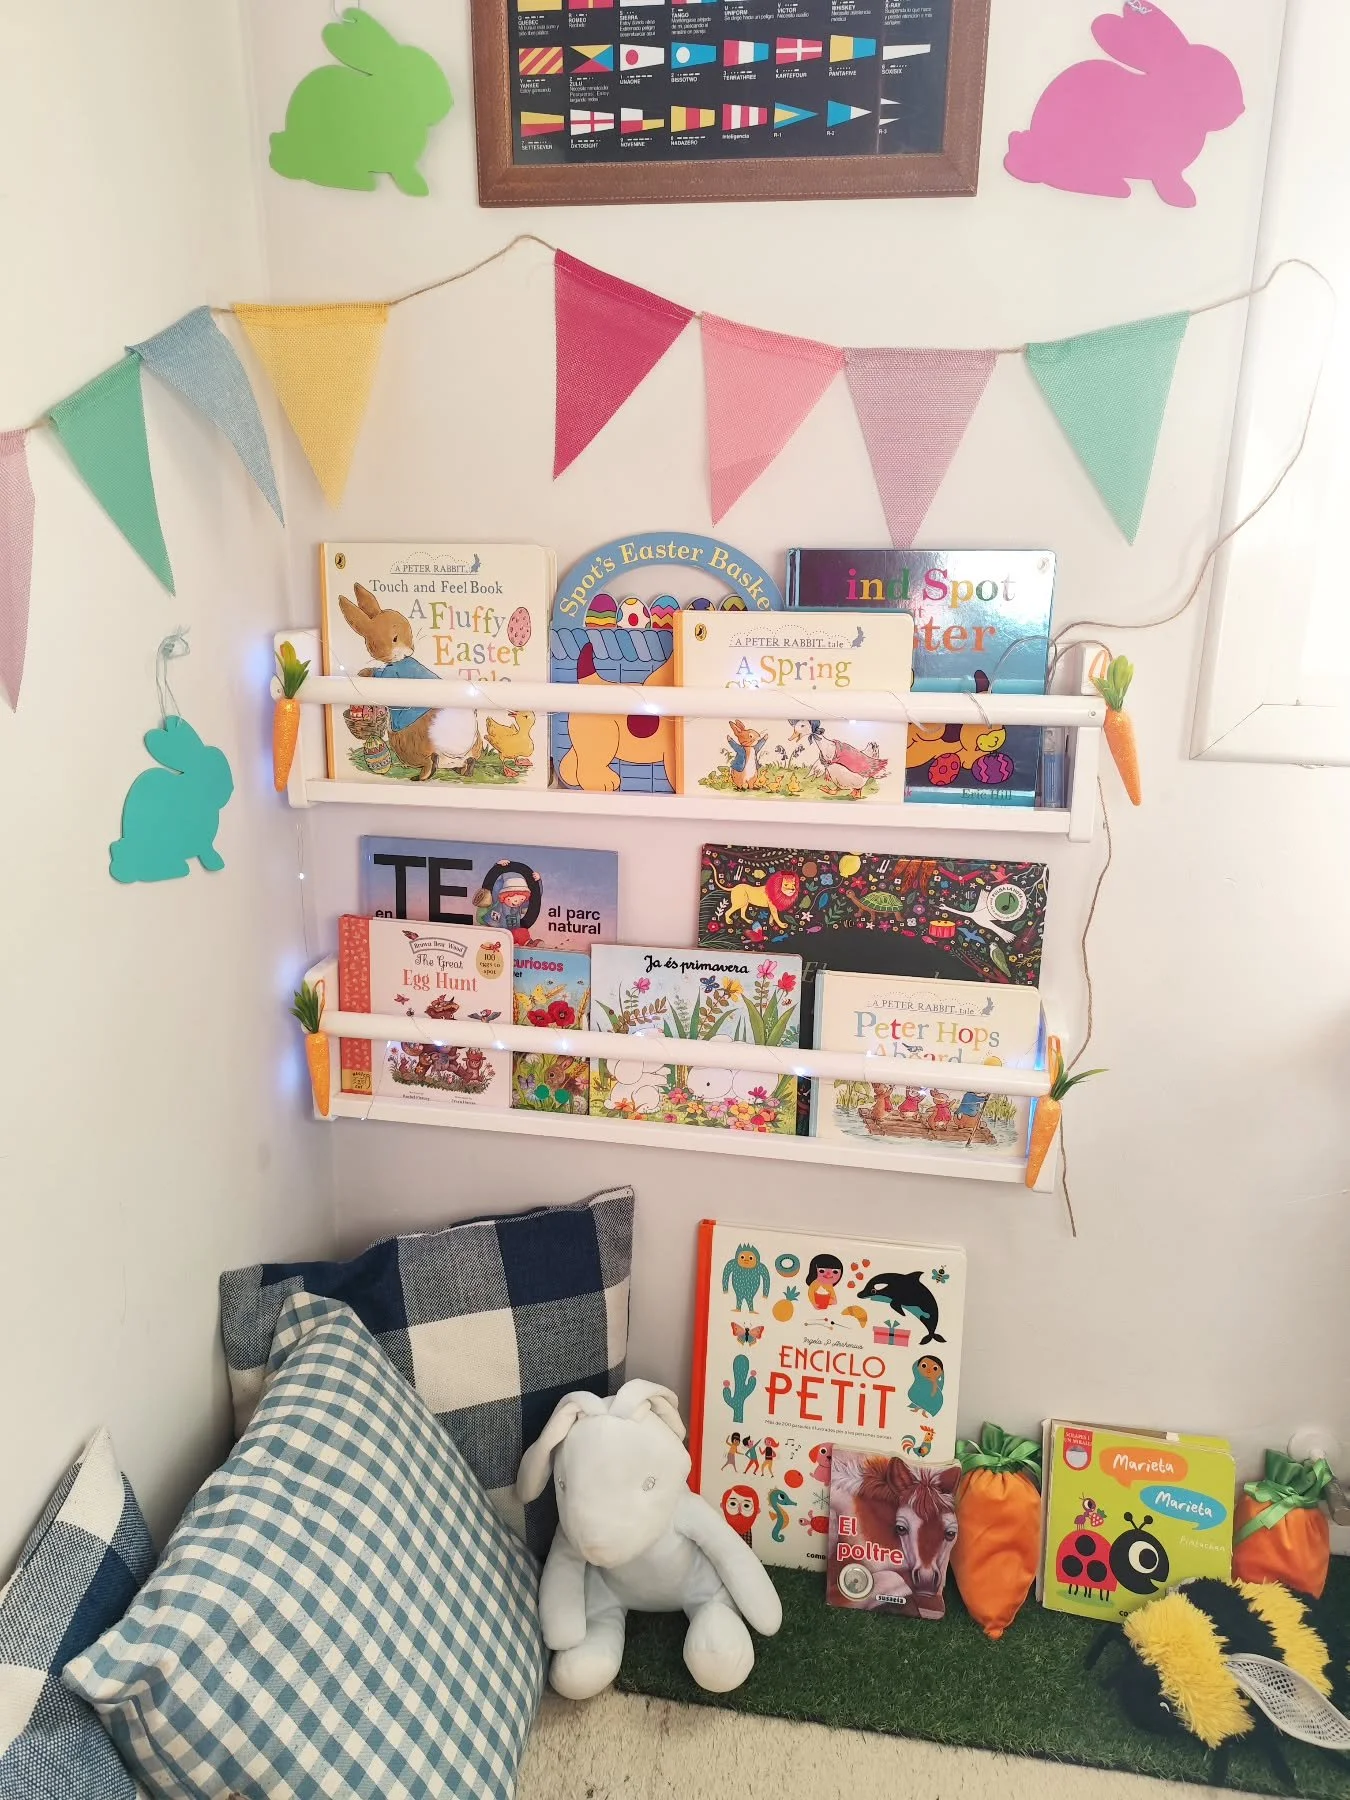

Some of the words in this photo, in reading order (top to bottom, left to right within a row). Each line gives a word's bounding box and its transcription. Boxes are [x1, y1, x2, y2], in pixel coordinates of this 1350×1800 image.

[402, 564, 430, 573] PETER
[433, 564, 466, 574] RABBIT
[619, 541, 704, 566] Easter
[708, 546, 776, 612] Baske
[369, 579, 408, 593] Touch
[413, 580, 436, 593] and
[440, 580, 467, 594] Feel
[470, 580, 504, 594] Book
[846, 567, 912, 602] ind
[922, 568, 1017, 609] Spot
[408, 598, 428, 620] A
[428, 602, 506, 638] Fluffy
[432, 634, 524, 666] Easter
[735, 638, 743, 647] A
[745, 637, 779, 648] PETER
[782, 638, 824, 648] RABBIT
[828, 640, 844, 649] tale
[736, 656, 754, 676] A
[760, 655, 852, 688] Spring
[961, 788, 987, 800] Eric
[990, 788, 1012, 800] Hill
[373, 853, 542, 928] TEO
[375, 909, 393, 920] en
[548, 906, 562, 918] al
[566, 908, 601, 924] parc
[548, 920, 602, 936] natural
[413, 941, 432, 950] Brown
[414, 953, 434, 967] The
[436, 954, 464, 972] Great
[484, 953, 496, 962] 100
[644, 954, 663, 973] Ja
[664, 956, 679, 970] és
[679, 959, 750, 974] primavera
[402, 968, 431, 992] Egg
[436, 971, 479, 993] Hunt
[873, 1000, 879, 1008] A
[882, 1000, 914, 1010] PETER
[918, 1002, 955, 1014] RABBIT
[958, 1008, 975, 1016] tale
[854, 1010, 930, 1041] Peter
[936, 1021, 1000, 1051] Hops
[779, 1344, 886, 1380] ENCICLO
[1112, 1453, 1175, 1474] Marieta
[1154, 1490, 1213, 1518] Marieta
[838, 1515, 858, 1536] El
[836, 1541, 904, 1565] poltre
